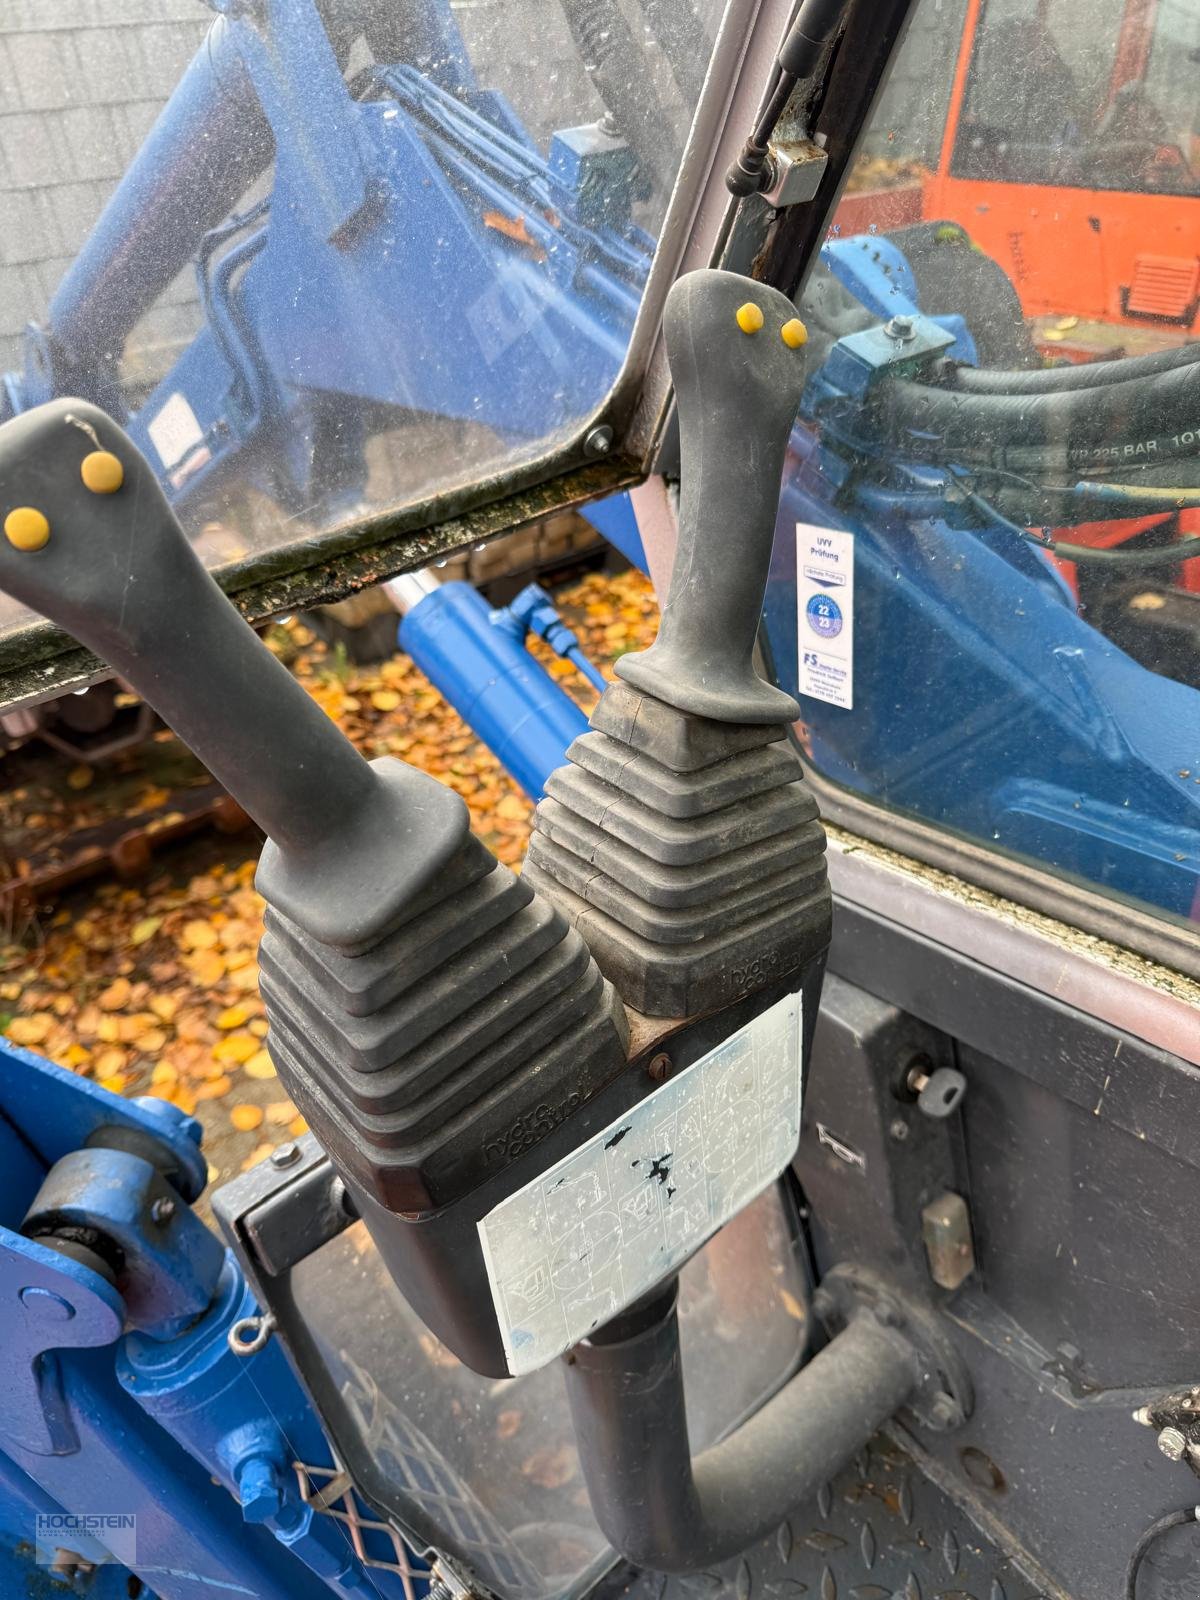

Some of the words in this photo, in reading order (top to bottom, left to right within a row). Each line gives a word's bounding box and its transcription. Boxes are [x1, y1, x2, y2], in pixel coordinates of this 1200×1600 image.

[1123, 440, 1158, 457] BAR
[816, 537, 832, 547] UVV
[810, 547, 840, 562] Prüfung
[818, 603, 830, 617] 22
[818, 615, 831, 629] 23
[804, 652, 818, 666] FS
